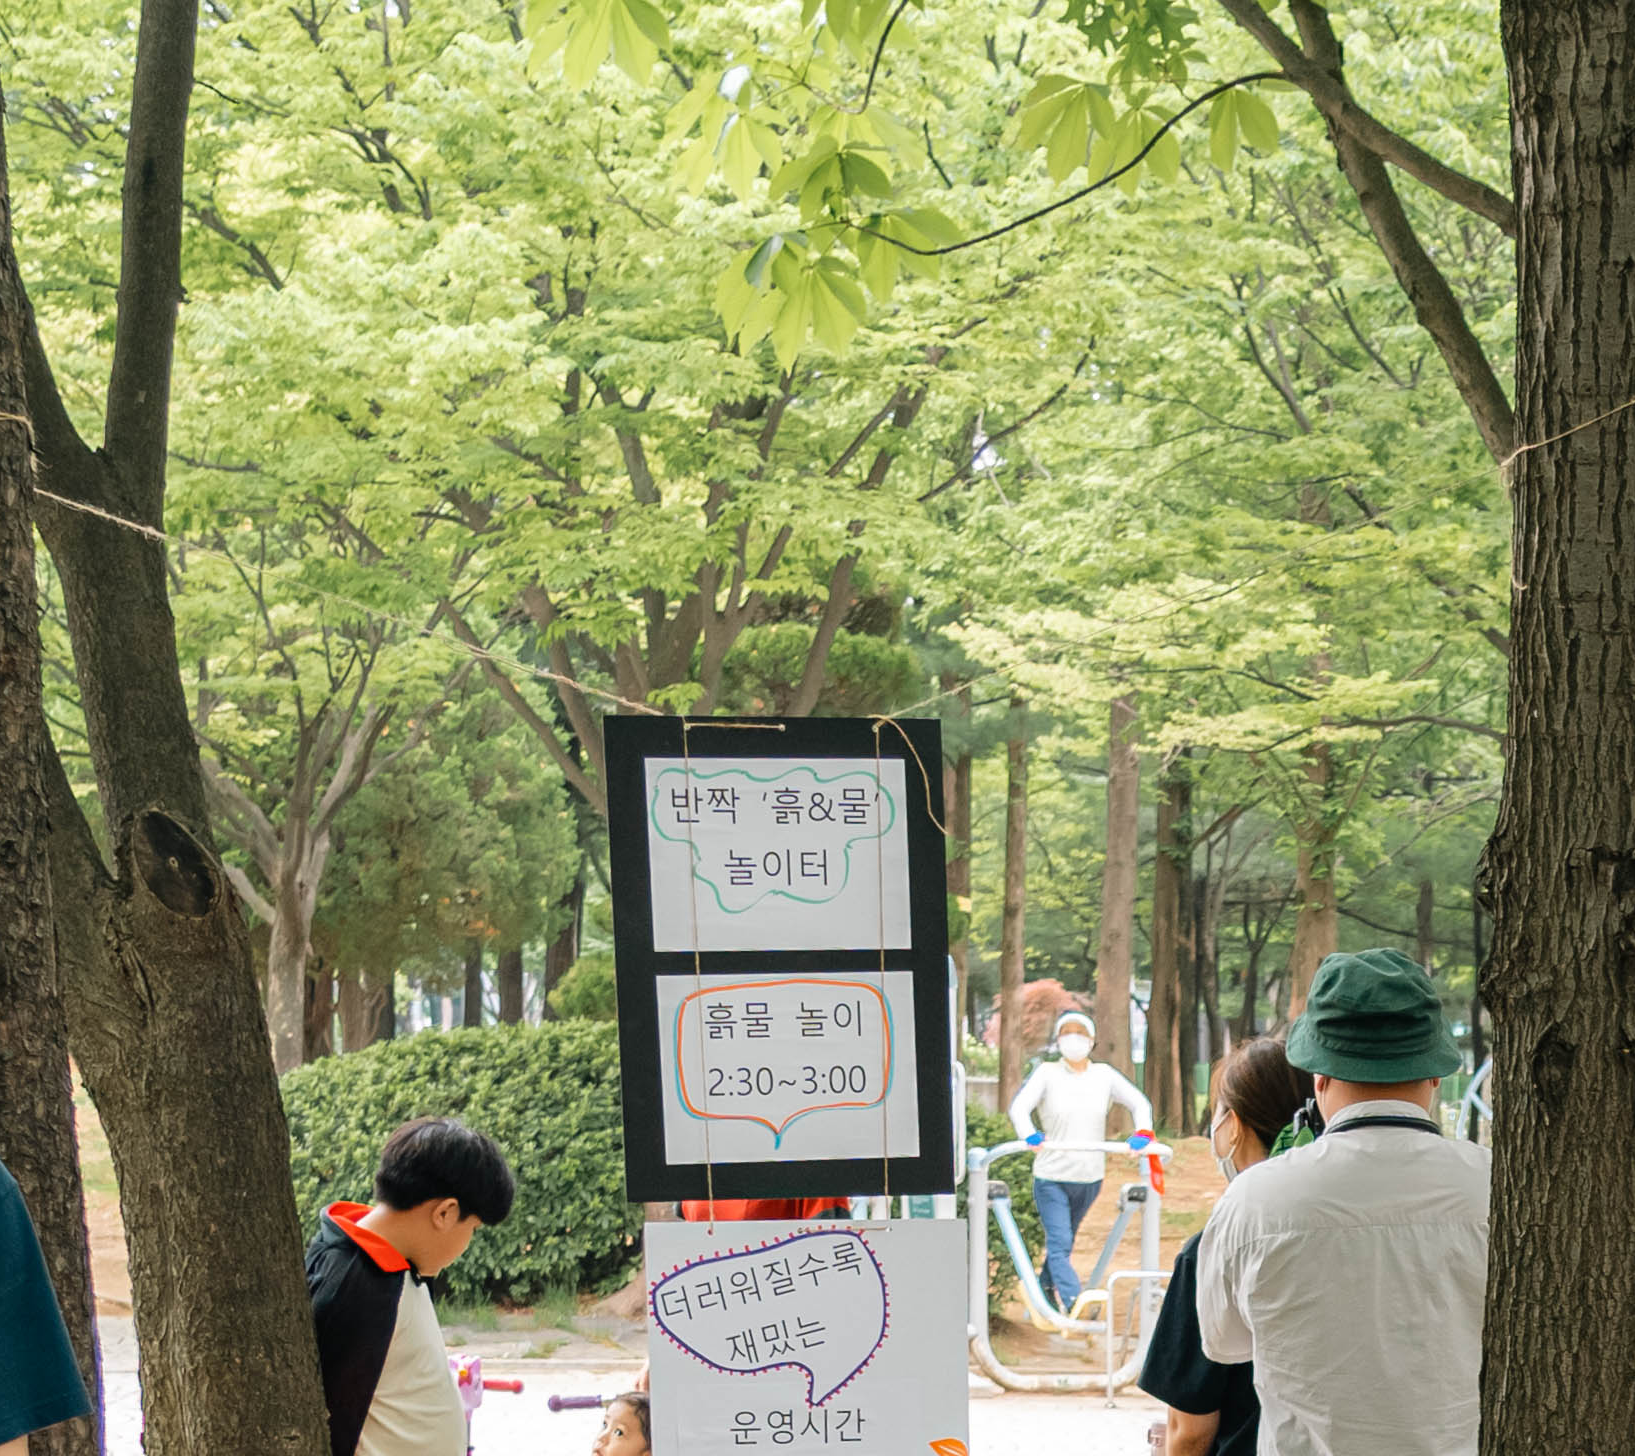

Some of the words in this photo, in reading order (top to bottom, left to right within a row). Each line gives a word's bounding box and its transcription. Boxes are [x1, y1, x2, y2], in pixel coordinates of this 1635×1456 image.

[670, 786, 741, 826] 반짝
[723, 847, 830, 887] 놀이터
[704, 1001, 774, 1040] 흙물
[794, 999, 863, 1039] 놀이
[708, 1064, 868, 1098] 2:30~3:00
[660, 1241, 864, 1321] 더러워질수록
[725, 1315, 827, 1365] 재밌는
[728, 1407, 867, 1446] 운영시간
